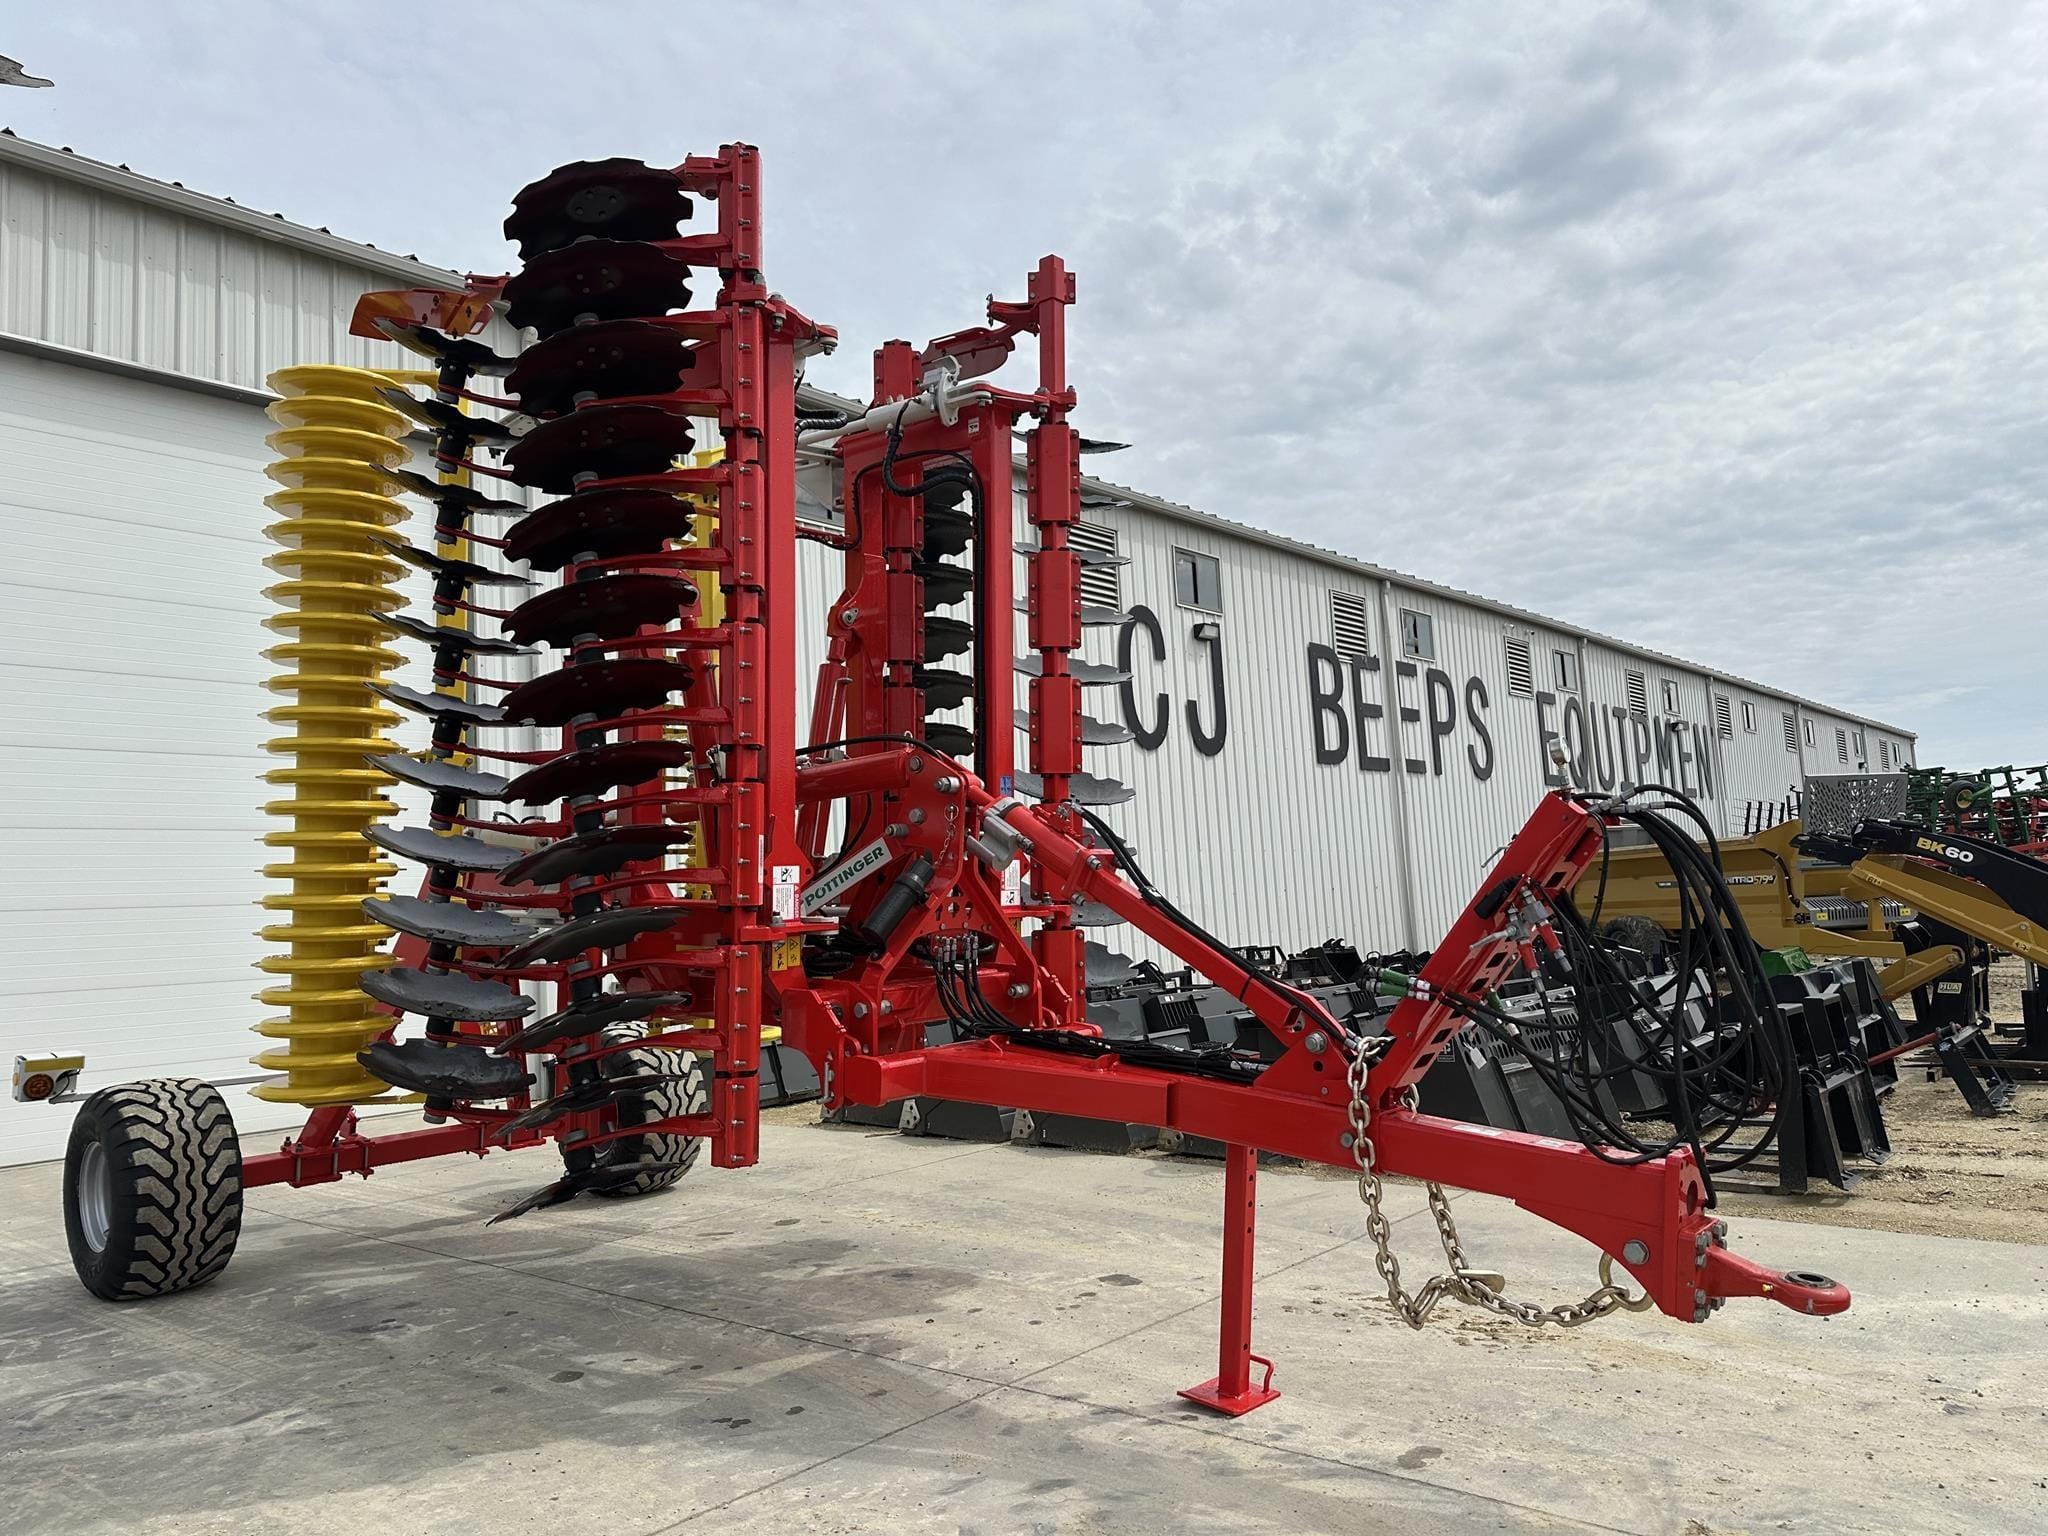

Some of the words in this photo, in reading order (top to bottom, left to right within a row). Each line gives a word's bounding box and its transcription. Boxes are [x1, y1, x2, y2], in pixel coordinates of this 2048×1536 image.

[1119, 605, 1227, 757] CJ
[1308, 641, 1493, 781] BEEPS
[1916, 836, 1974, 863] BK60
